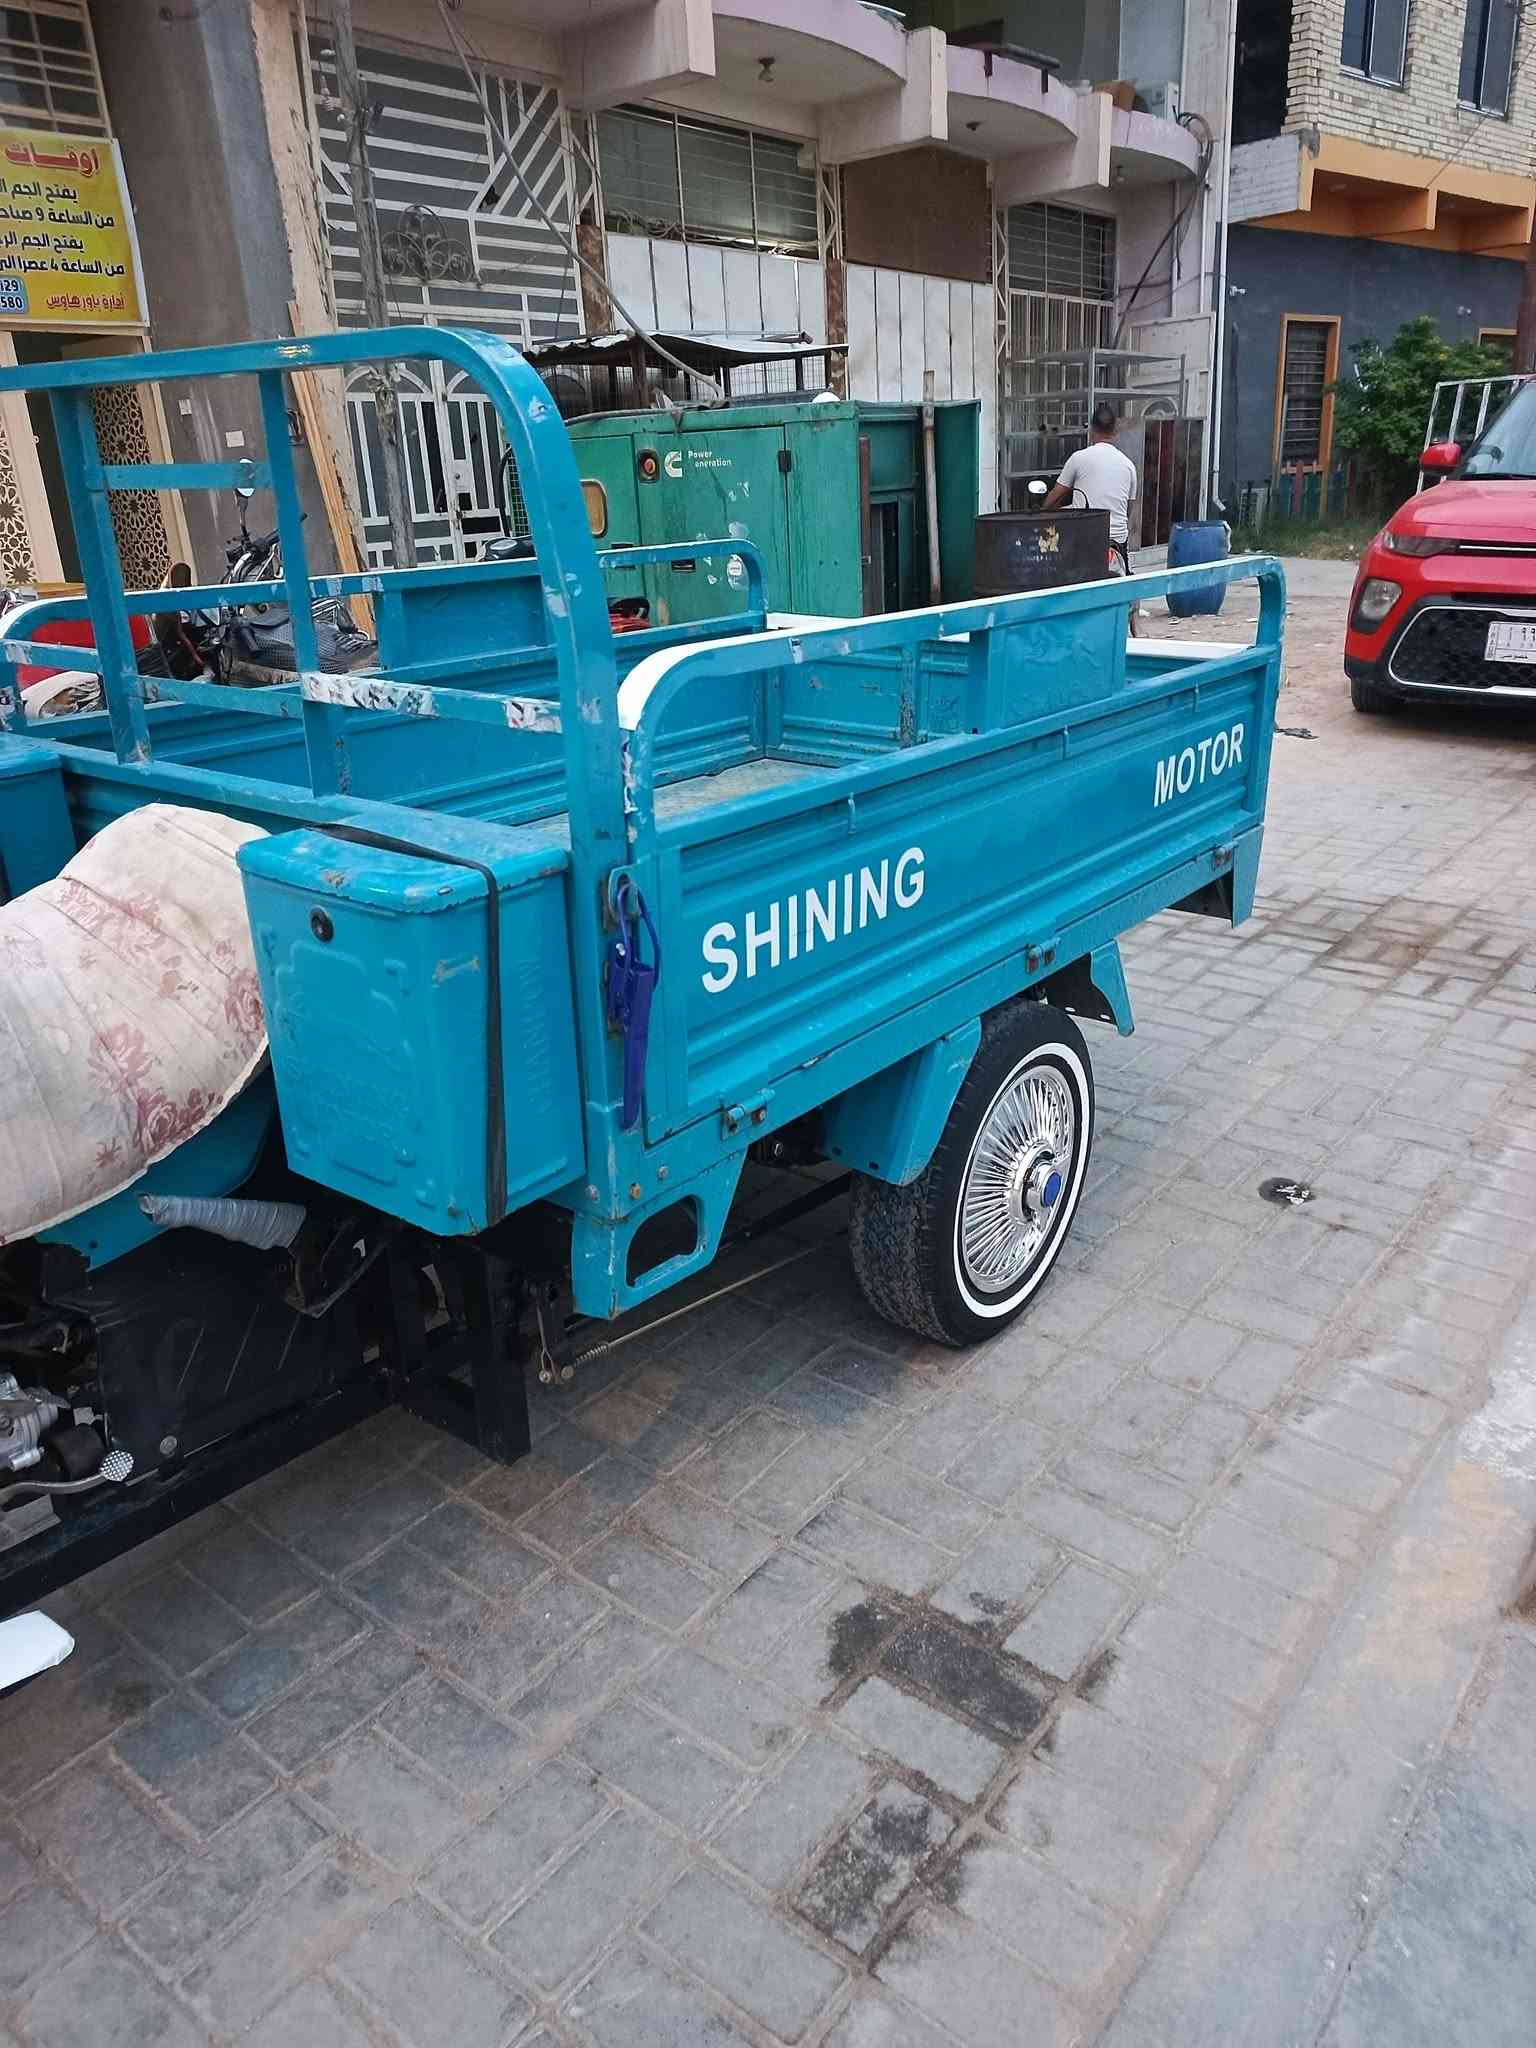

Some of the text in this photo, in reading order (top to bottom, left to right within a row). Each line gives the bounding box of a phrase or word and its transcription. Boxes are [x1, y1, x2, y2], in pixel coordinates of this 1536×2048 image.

[11, 181, 42, 199] الجم
[45, 183, 79, 203] يفتح
[35, 206, 44, 221] 9
[48, 207, 93, 226] الساعة
[95, 213, 115, 229] من
[22, 232, 50, 250] الجم
[53, 235, 84, 253] يفتح
[18, 255, 48, 273] عصرا
[61, 258, 102, 274] الساعة
[105, 263, 125, 277] من
[687, 450, 713, 459] Power
[702, 723, 1244, 993] SHINING MOTOR
